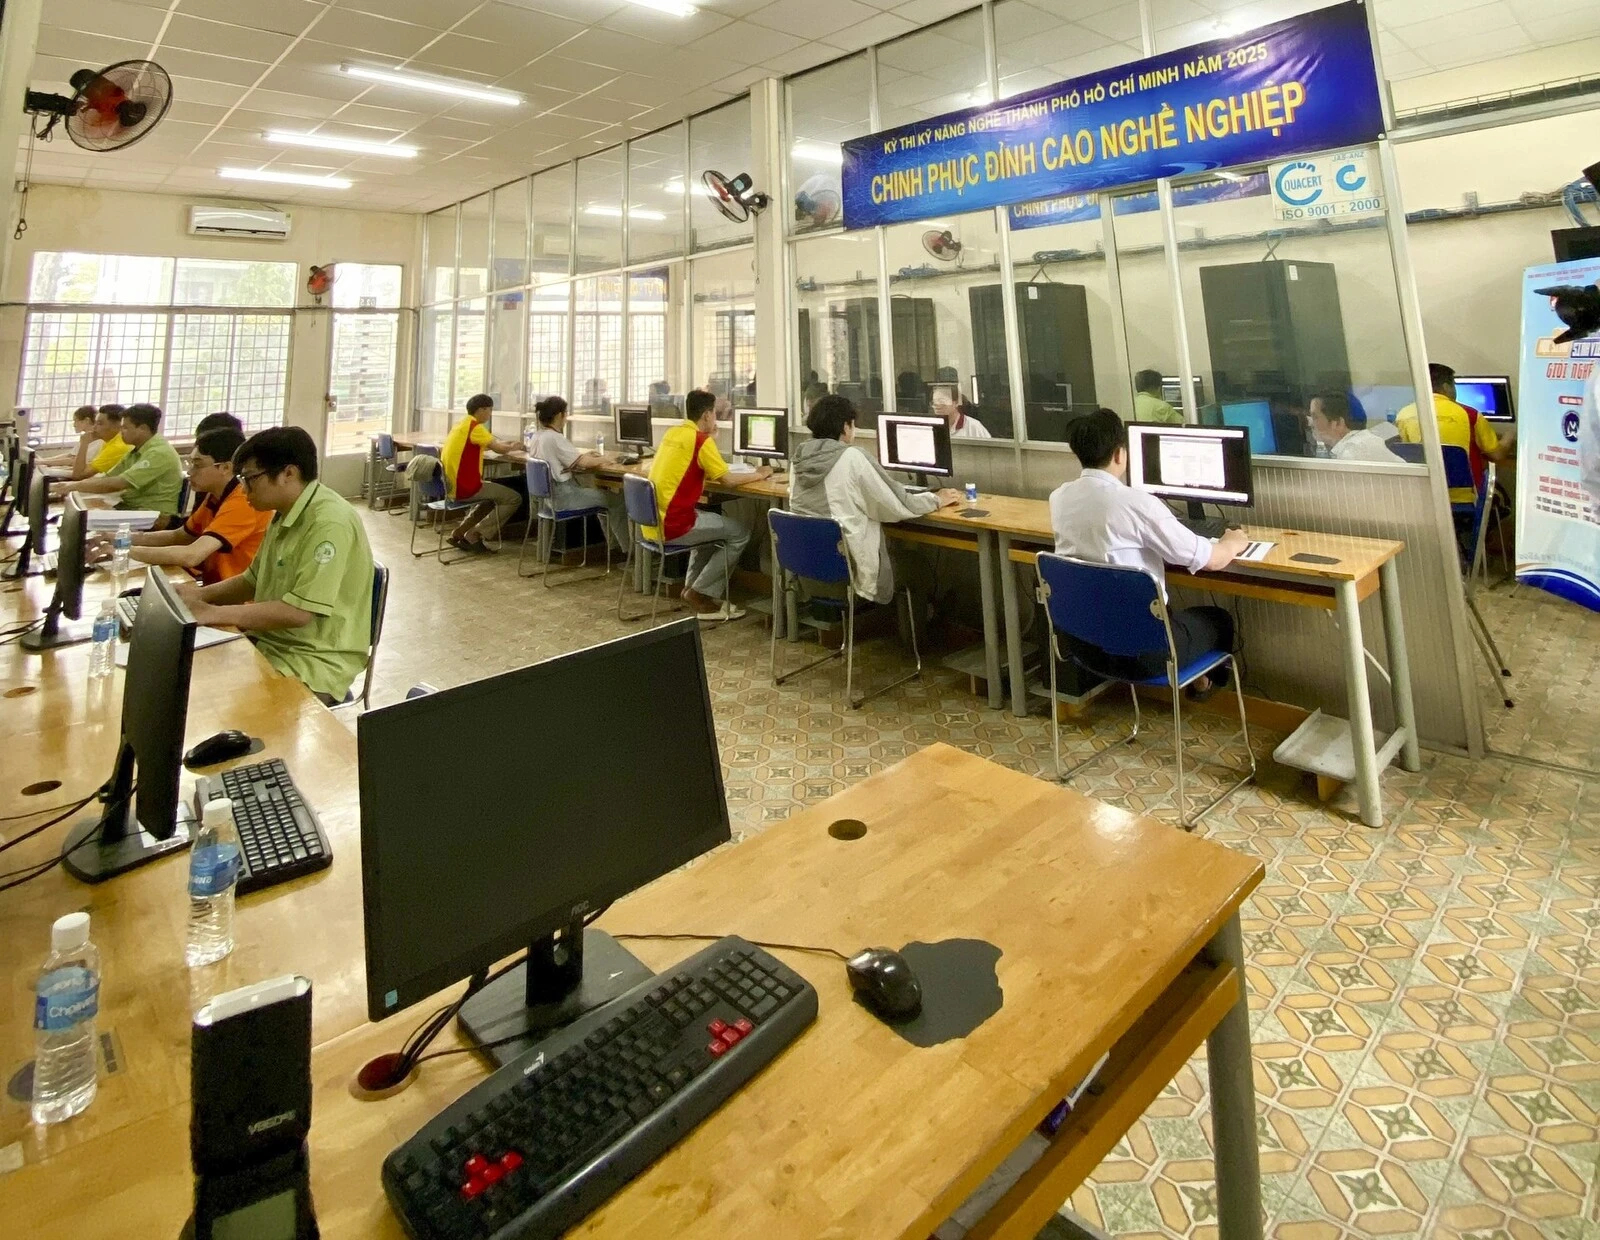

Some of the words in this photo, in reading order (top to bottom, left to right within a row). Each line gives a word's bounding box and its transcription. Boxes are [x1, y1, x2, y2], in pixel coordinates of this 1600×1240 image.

[884, 137, 897, 154] KỲ
[900, 135, 916, 150] THI
[917, 128, 932, 146] KỸ
[934, 122, 965, 142] NĂNG
[1004, 101, 1048, 124] THÀNH
[1051, 90, 1080, 113] PHỐ
[1109, 73, 1135, 99] CHÍ
[1139, 65, 1179, 92] MINH
[1184, 55, 1222, 79] NĂM
[1227, 43, 1268, 68] 2025
[871, 167, 923, 204] CHINH
[927, 154, 980, 196] PHỤC
[984, 141, 1036, 182] ĐỈNH
[1042, 129, 1095, 171] CAO
[1101, 103, 1178, 160] NGHỀ
[1184, 81, 1306, 143] NGHIỆP
[1282, 209, 1304, 220] ISO
[1307, 204, 1336, 217] 9001
[1350, 199, 1380, 212] 2000
[1284, 175, 1323, 191] QUACERT
